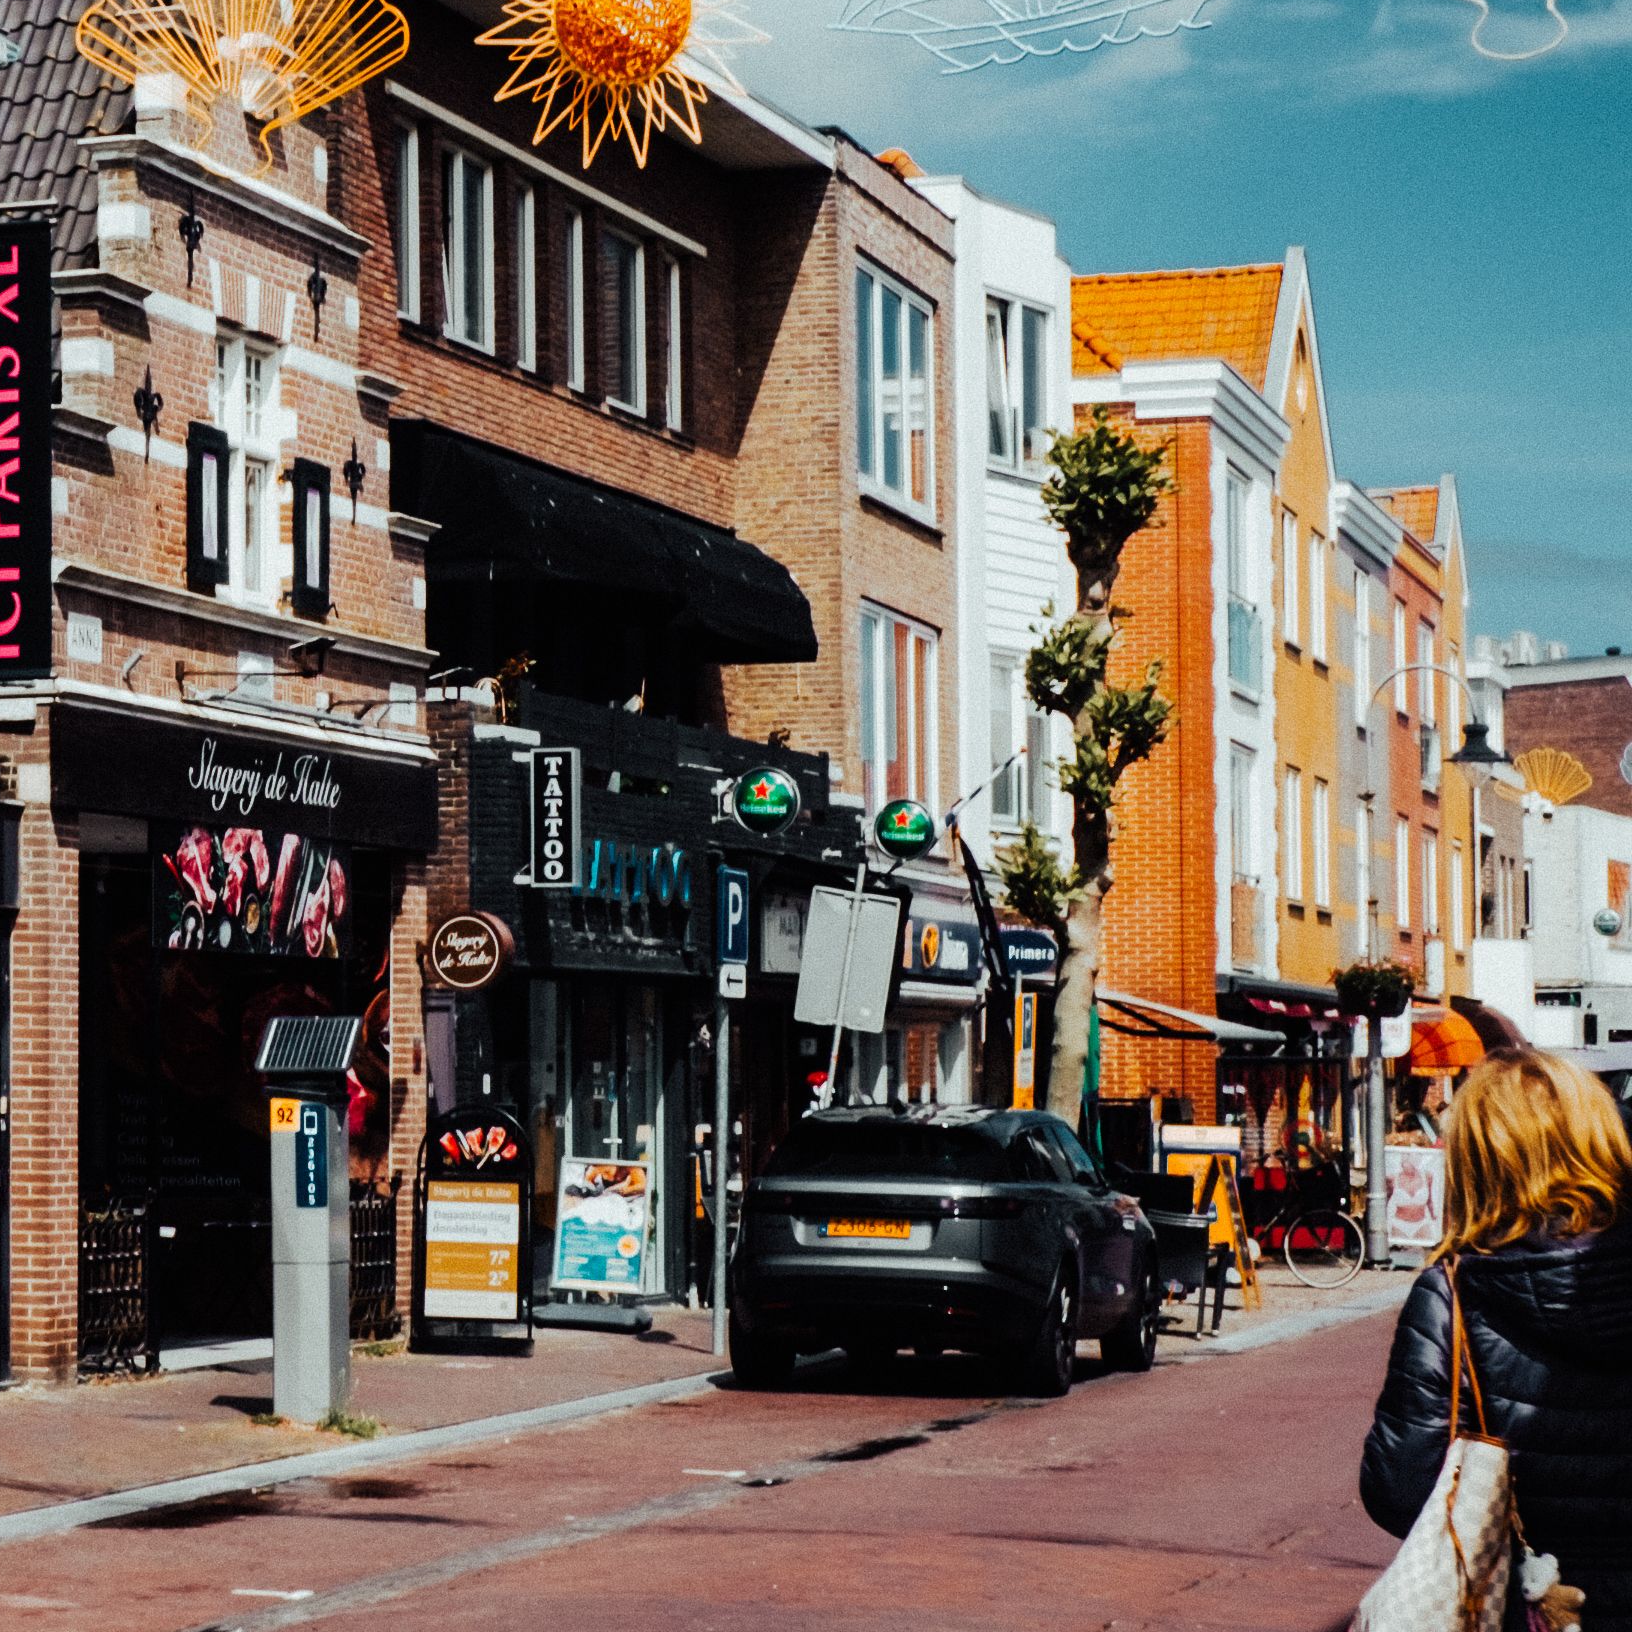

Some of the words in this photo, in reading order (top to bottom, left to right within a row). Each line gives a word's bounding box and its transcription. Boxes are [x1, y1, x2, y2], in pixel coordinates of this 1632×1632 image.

[189, 738, 264, 815] Slagerij
[264, 752, 288, 801] de
[543, 756, 564, 880] TATTOO
[571, 837, 693, 909] ATTOO
[728, 881, 743, 950] P
[1008, 945, 1055, 961] Primera
[276, 1107, 294, 1123] 92
